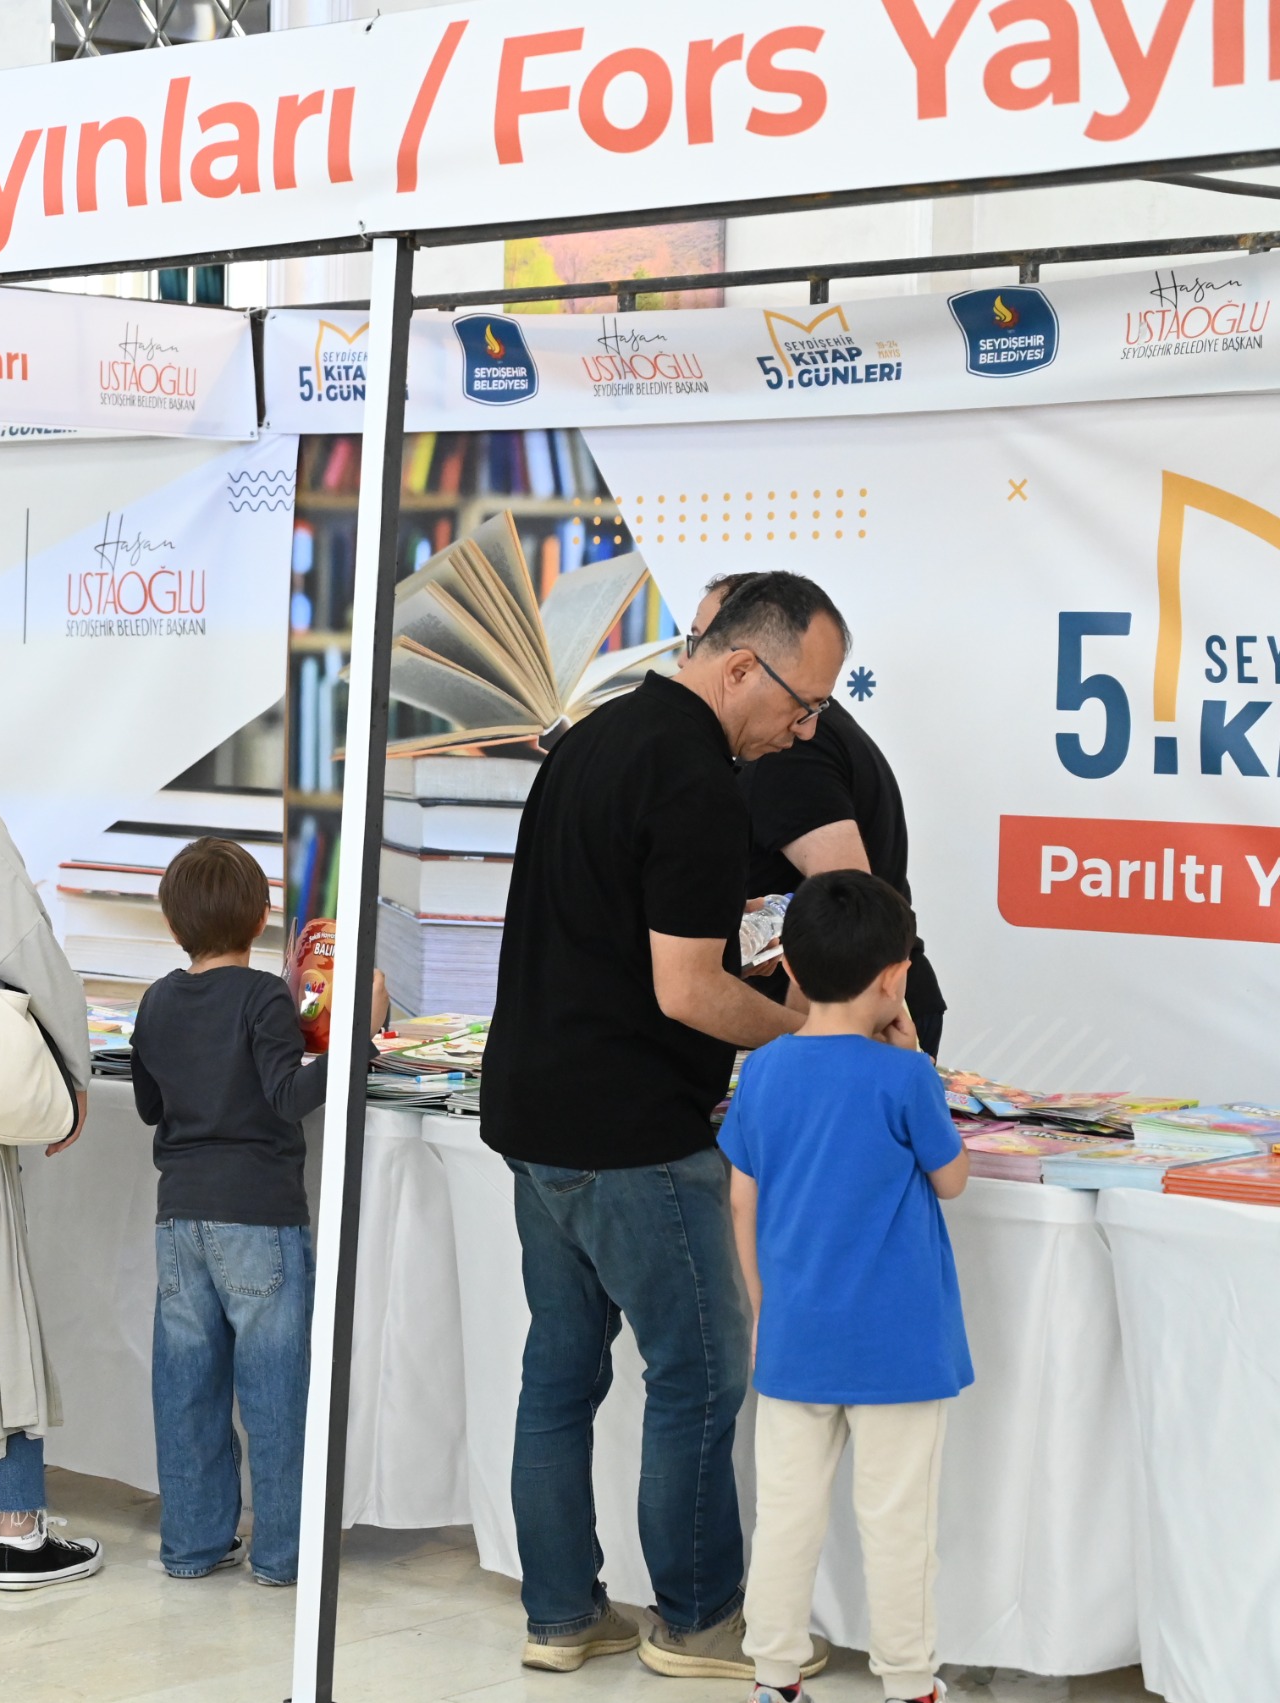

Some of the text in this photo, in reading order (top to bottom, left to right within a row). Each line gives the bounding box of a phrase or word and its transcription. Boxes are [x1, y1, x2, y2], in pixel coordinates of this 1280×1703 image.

[396, 19, 470, 195] /
[494, 25, 827, 166] Fors
[1126, 300, 1271, 345] USTAOĞLU
[100, 360, 197, 397] USTAOĞLU
[582, 351, 703, 382] USTAOĞLU
[67, 566, 205, 616] USTAOĞLU
[1040, 844, 1222, 904] Parıltı
